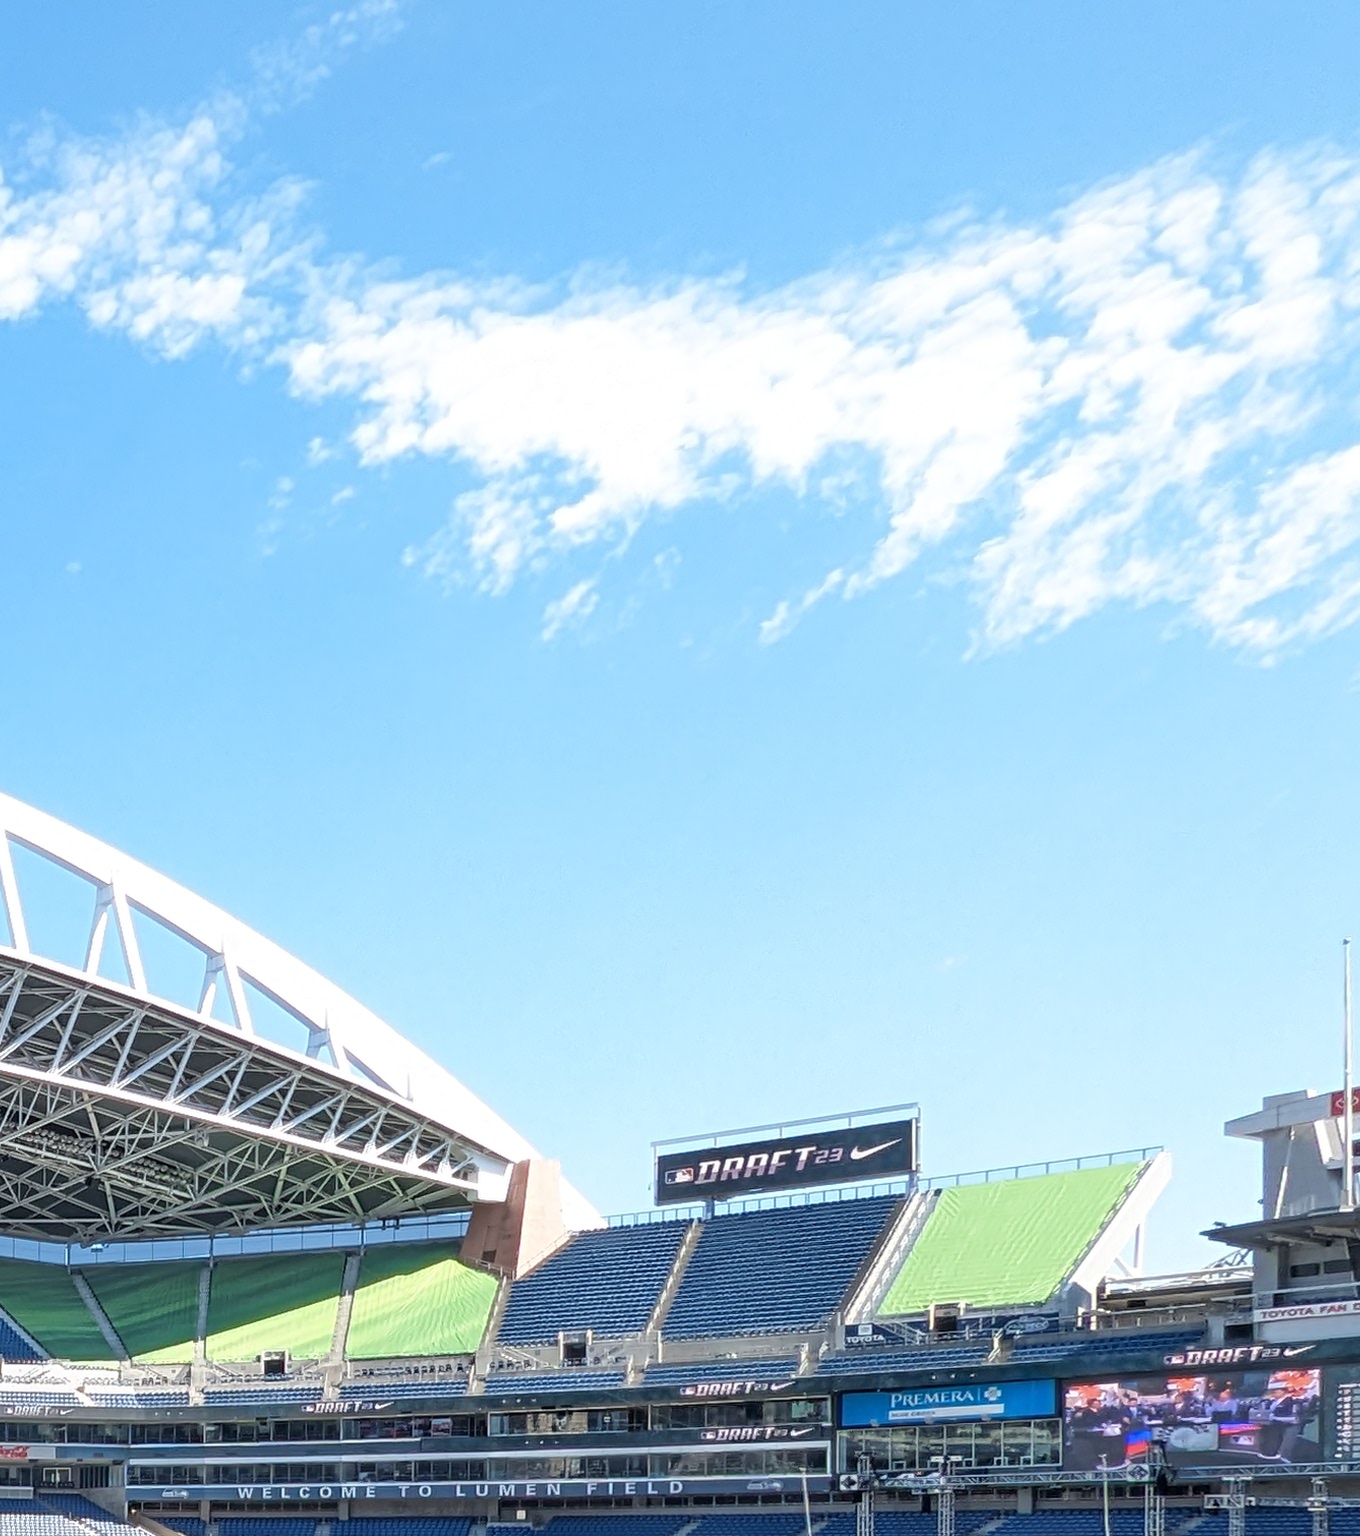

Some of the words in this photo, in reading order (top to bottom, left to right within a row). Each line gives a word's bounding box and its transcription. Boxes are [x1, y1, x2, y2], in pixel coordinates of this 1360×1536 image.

[694, 1147, 818, 1184] DRAFT
[815, 1149, 844, 1164] 23
[1260, 1307, 1315, 1320] TOYOTA
[1318, 1302, 1348, 1314] FAN
[845, 1335, 885, 1347] TOYOTA
[1185, 1346, 1264, 1366] DRAFT
[1262, 1350, 1281, 1360] 23
[694, 1381, 755, 1397] DRAFT
[314, 1401, 362, 1413] DRAFT
[890, 1390, 974, 1409] PREMERA
[714, 1427, 775, 1441] DRAFT
[237, 1486, 377, 1500] WELCOME
[398, 1485, 433, 1498] TO
[454, 1484, 562, 1498] LUMEN
[585, 1481, 685, 1496] FIELD
